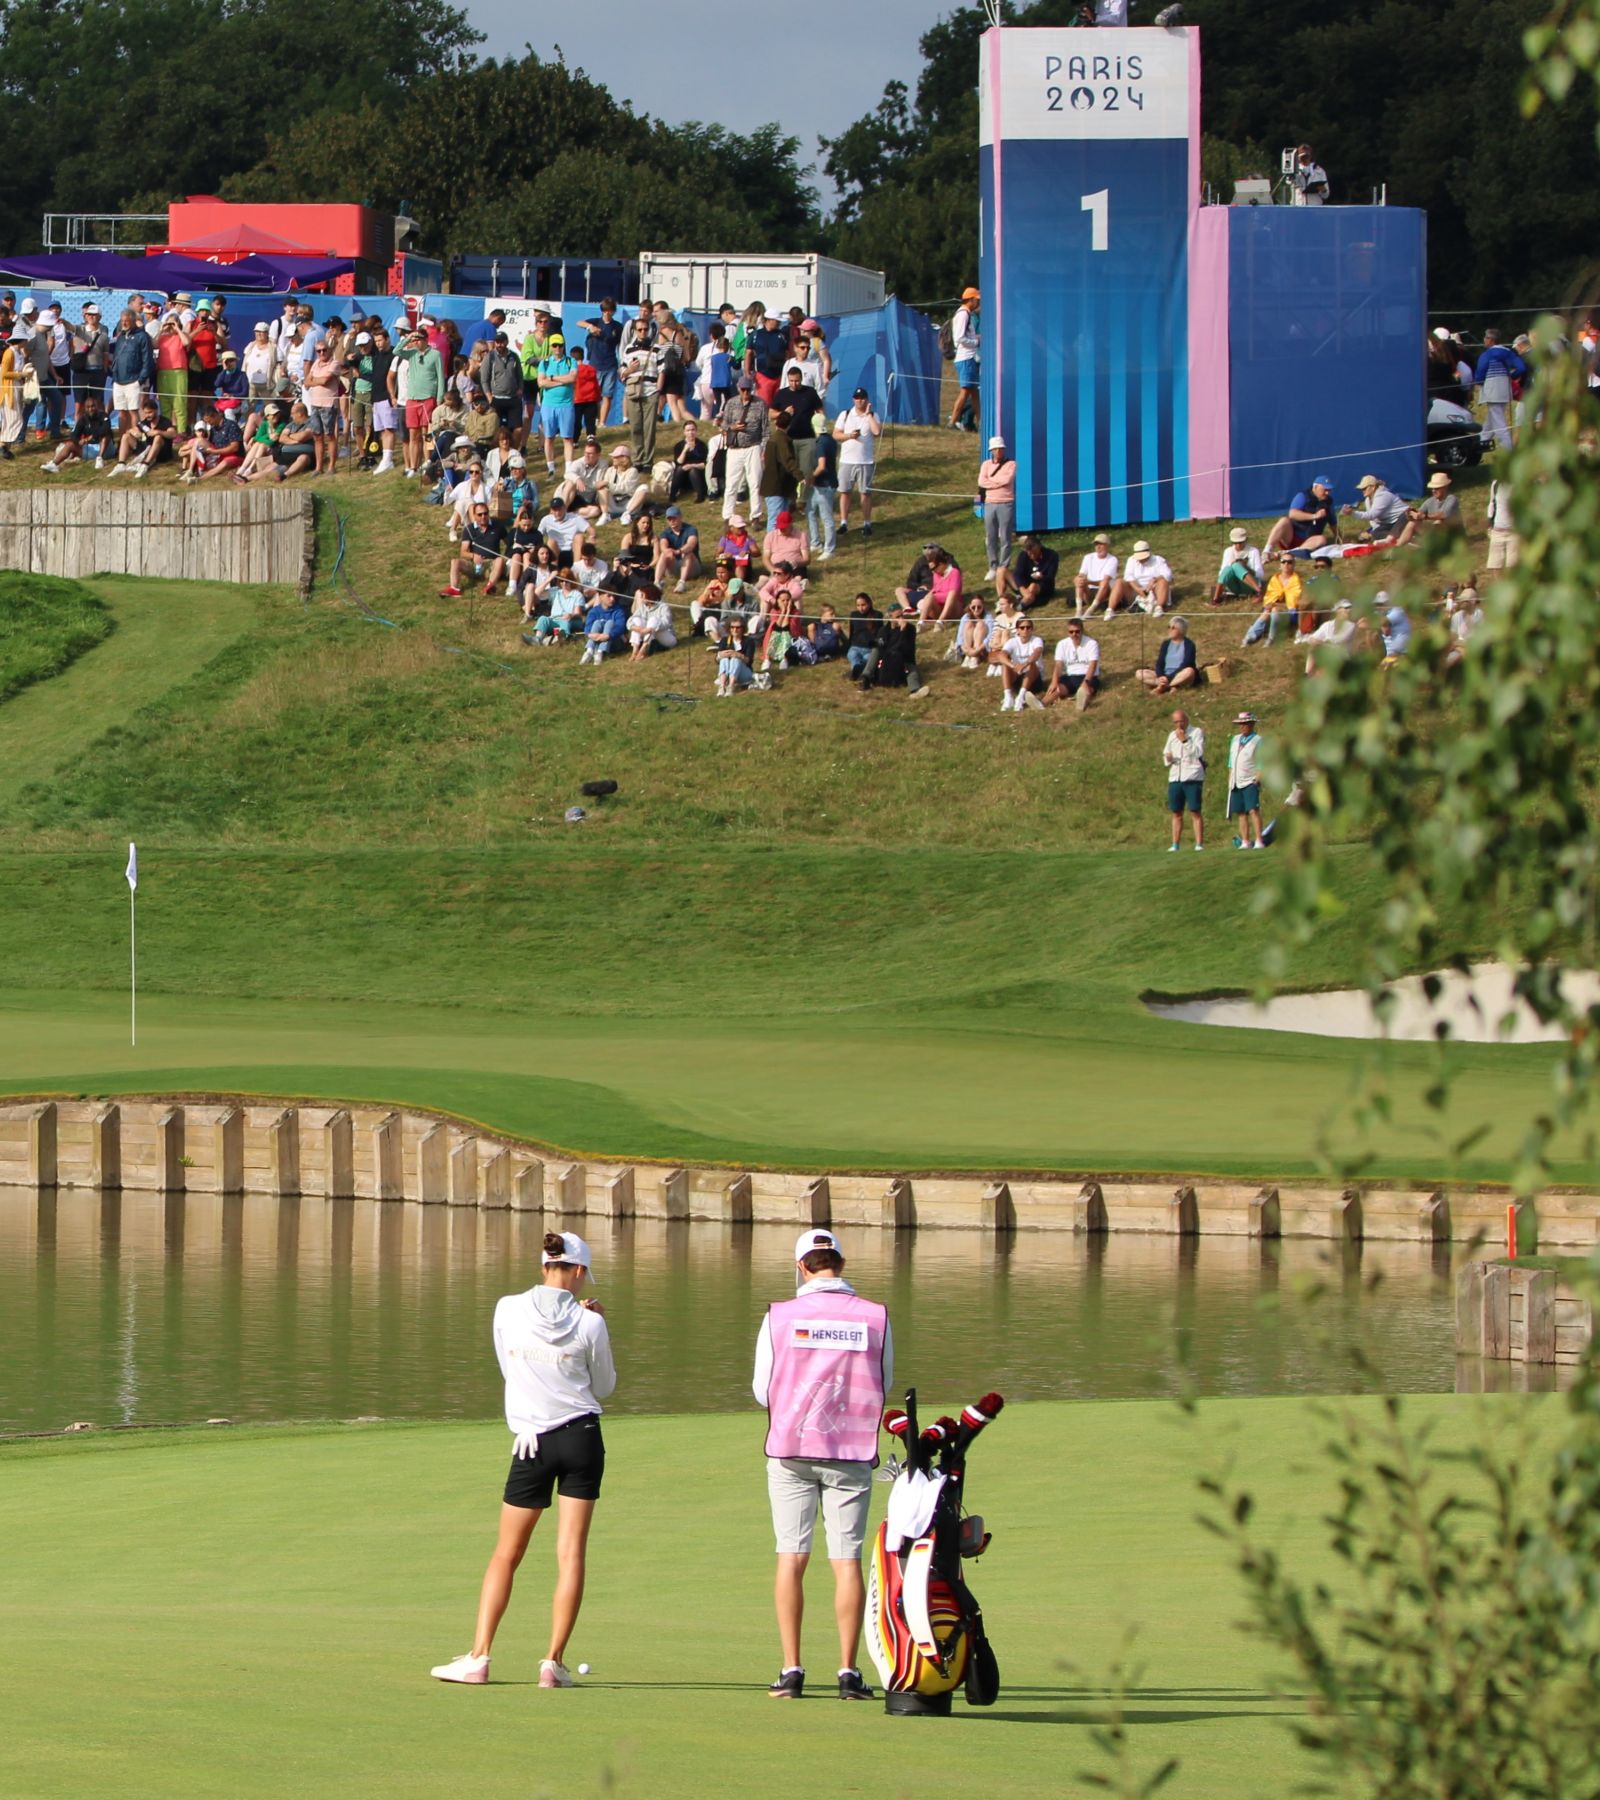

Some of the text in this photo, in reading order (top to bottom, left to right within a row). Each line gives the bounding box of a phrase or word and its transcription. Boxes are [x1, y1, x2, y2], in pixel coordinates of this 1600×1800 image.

[1047, 87, 1143, 111] 2024
[1081, 188, 1109, 250] 1
[754, 280, 779, 288] 221005
[812, 1329, 863, 1342] HENSELEIT
